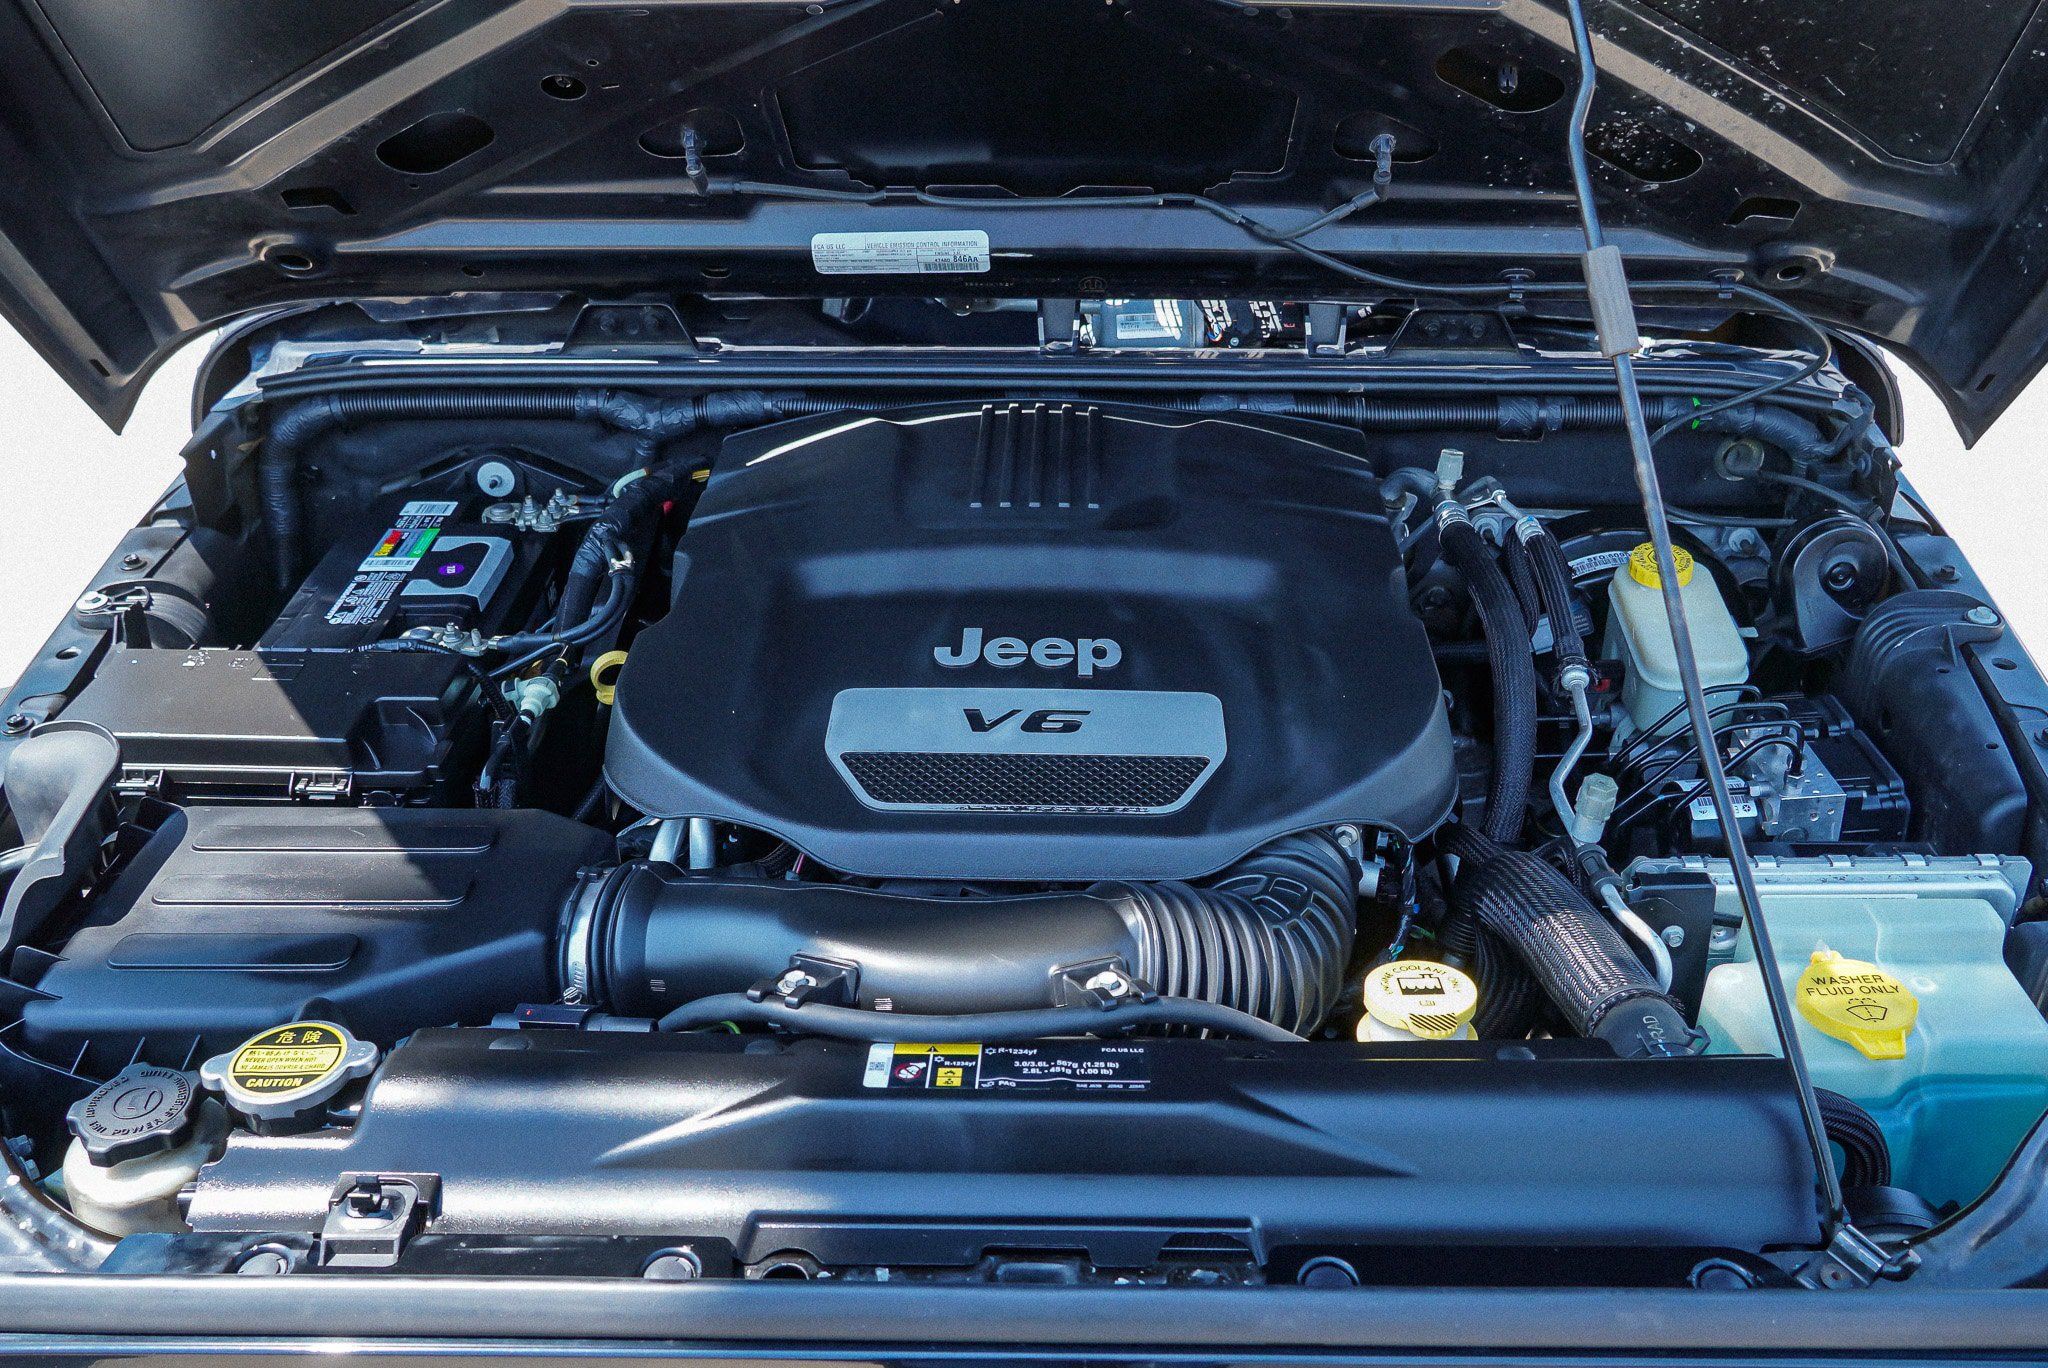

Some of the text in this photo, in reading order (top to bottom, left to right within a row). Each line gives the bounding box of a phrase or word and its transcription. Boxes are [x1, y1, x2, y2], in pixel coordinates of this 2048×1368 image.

[889, 241, 915, 249] EMISSION
[934, 628, 1122, 678] Jeep
[962, 708, 1092, 734] V6
[1392, 965, 1447, 975] COOLANT
[1811, 974, 1884, 986] WASHER
[1805, 985, 1900, 997] FLUID ONLY
[275, 1030, 323, 1044] 危険
[997, 1047, 1038, 1056] R-1234yf
[944, 1060, 976, 1068] R-1234yf
[1106, 1061, 1120, 1069] lb)
[1100, 1068, 1114, 1076] lb)
[245, 1077, 304, 1088] CAUTION
[85, 1076, 130, 1119] APPROVED
[111, 1118, 163, 1136] POWER
